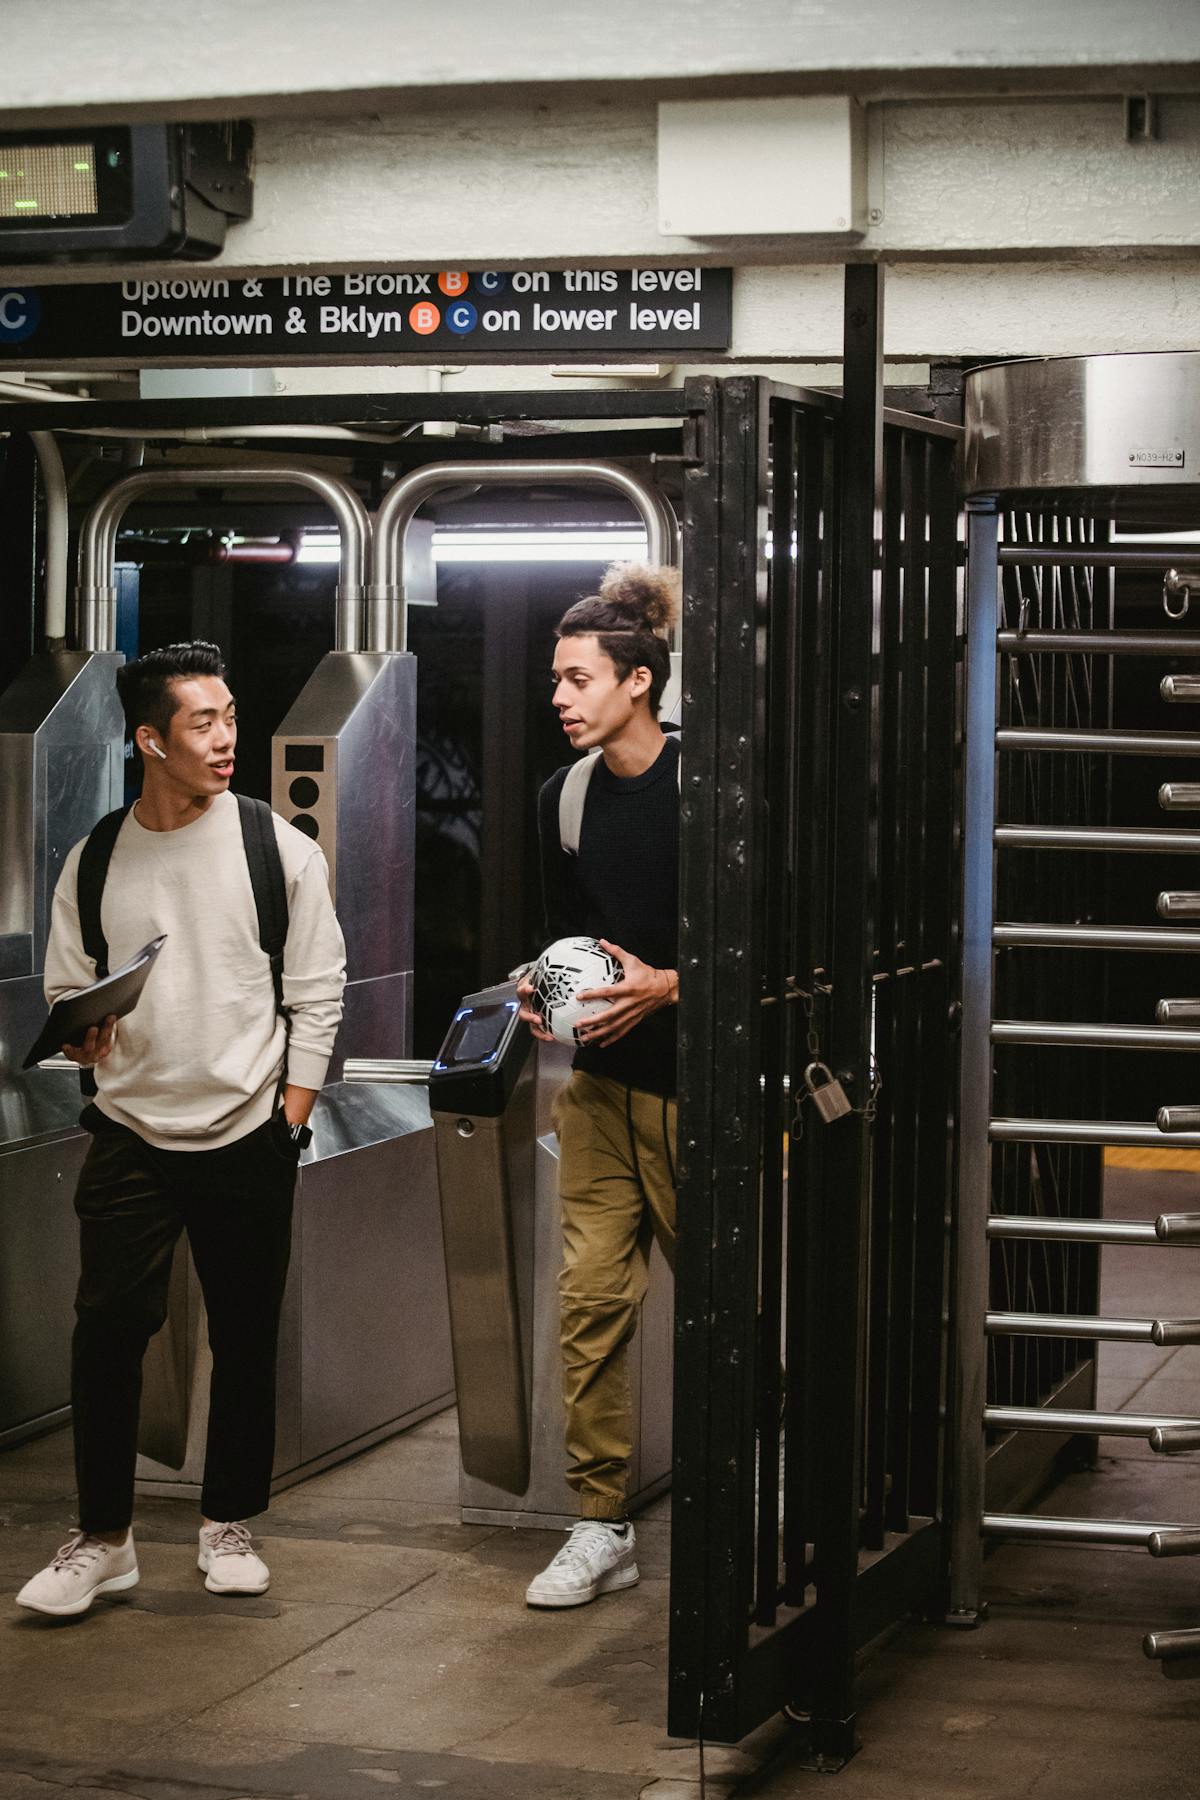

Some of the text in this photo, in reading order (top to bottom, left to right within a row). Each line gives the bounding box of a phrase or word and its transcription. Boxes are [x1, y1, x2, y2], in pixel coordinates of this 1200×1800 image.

[122, 280, 230, 305] Uptown
[242, 277, 264, 297] &
[344, 273, 431, 295] Bronx
[446, 272, 461, 290] B
[482, 271, 498, 289] C
[512, 271, 550, 292] on
[563, 269, 618, 292] this
[631, 268, 701, 292] level
[0, 292, 26, 329] C
[121, 302, 701, 338] Downtown & Bklyn B C on lower level
